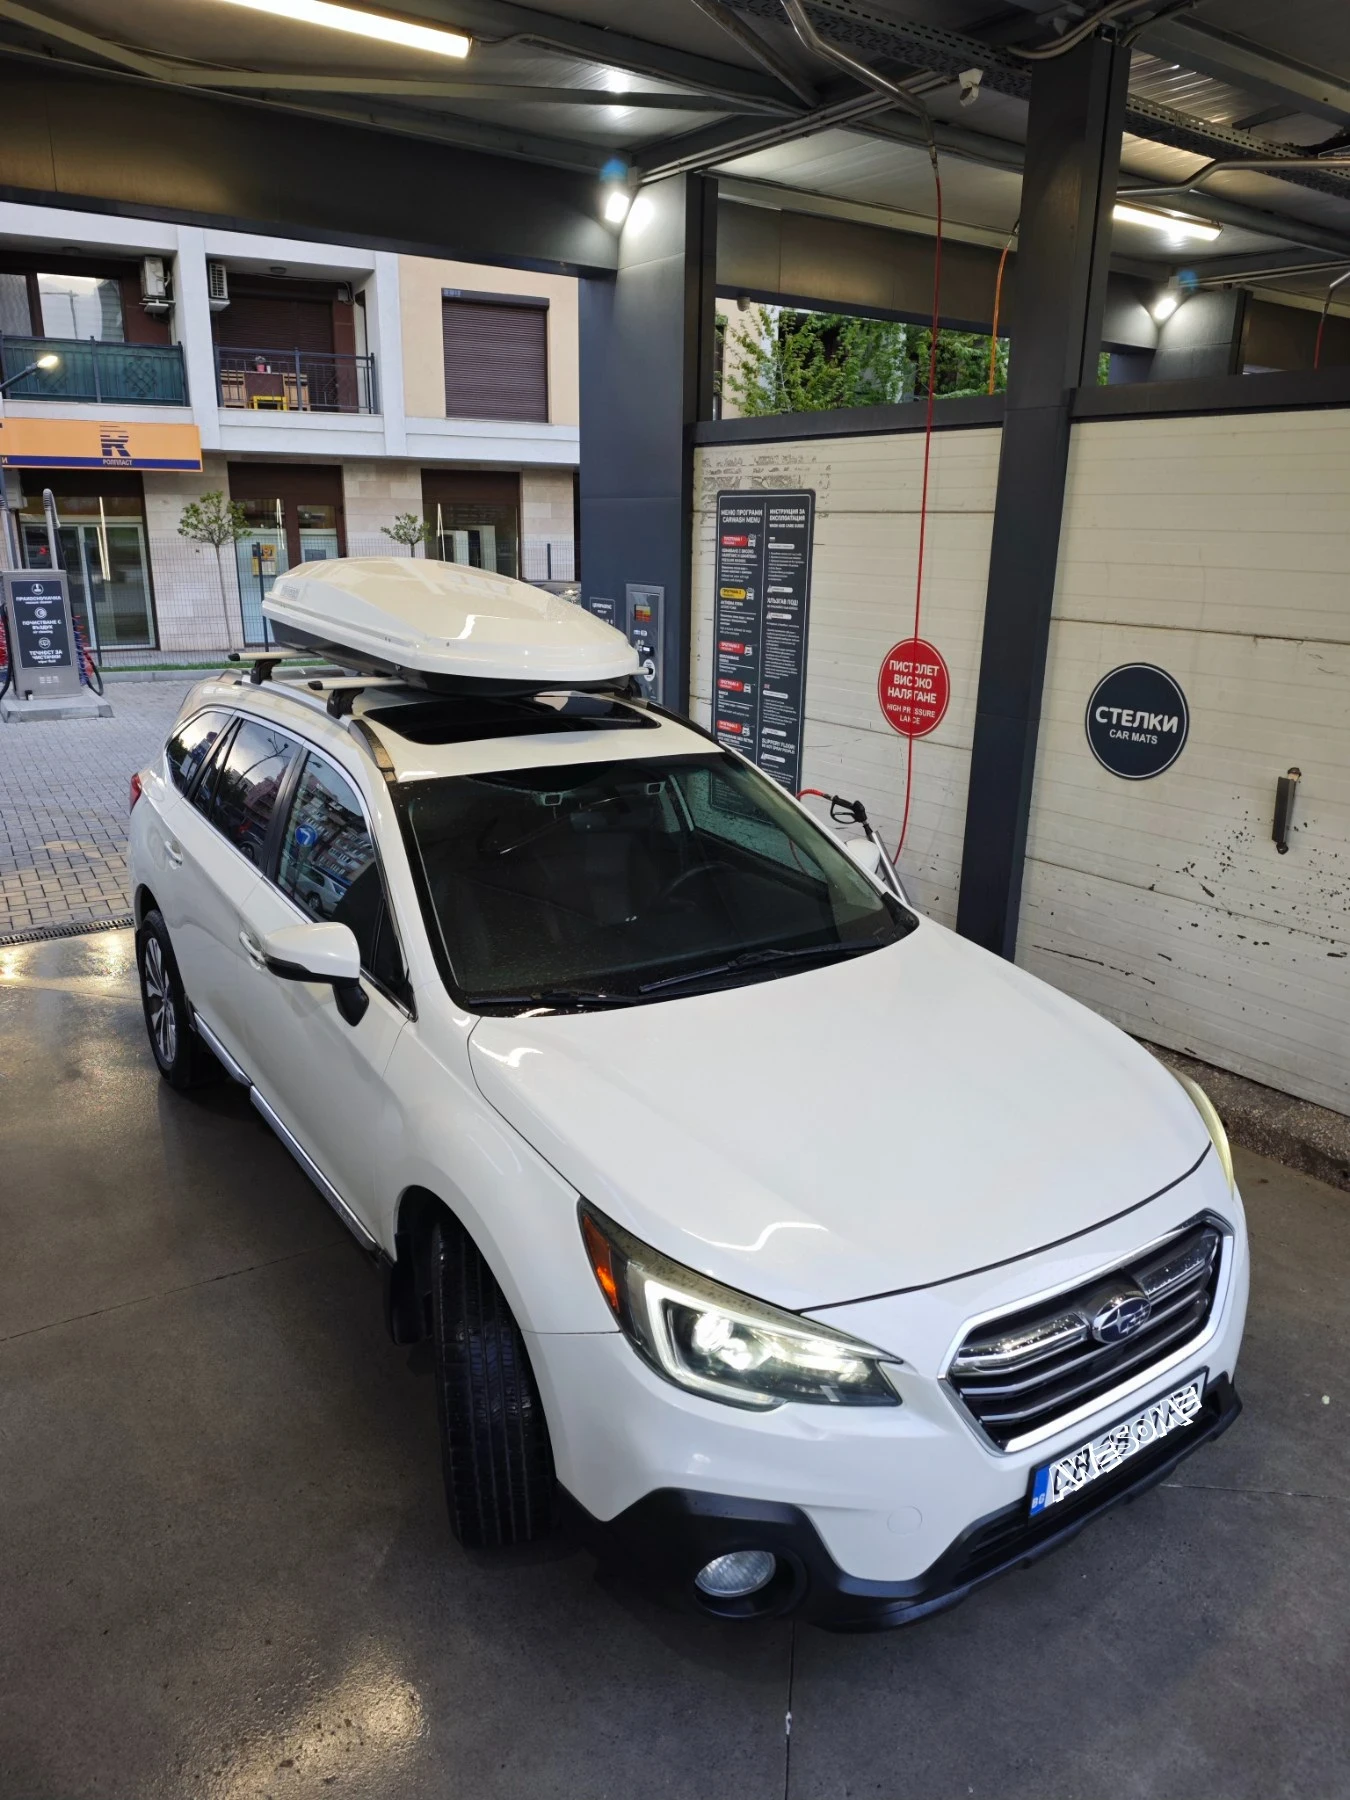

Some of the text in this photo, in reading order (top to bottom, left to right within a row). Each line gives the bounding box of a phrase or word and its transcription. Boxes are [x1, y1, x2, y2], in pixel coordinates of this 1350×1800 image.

[746, 516, 760, 524] MENU
[887, 686, 937, 704] НАЛЯГАНЕ
[886, 703, 936, 719] HIGH PRSSURE
[1095, 706, 1179, 734] СТЕЛКИ
[1109, 729, 1158, 745] CAR MATS
